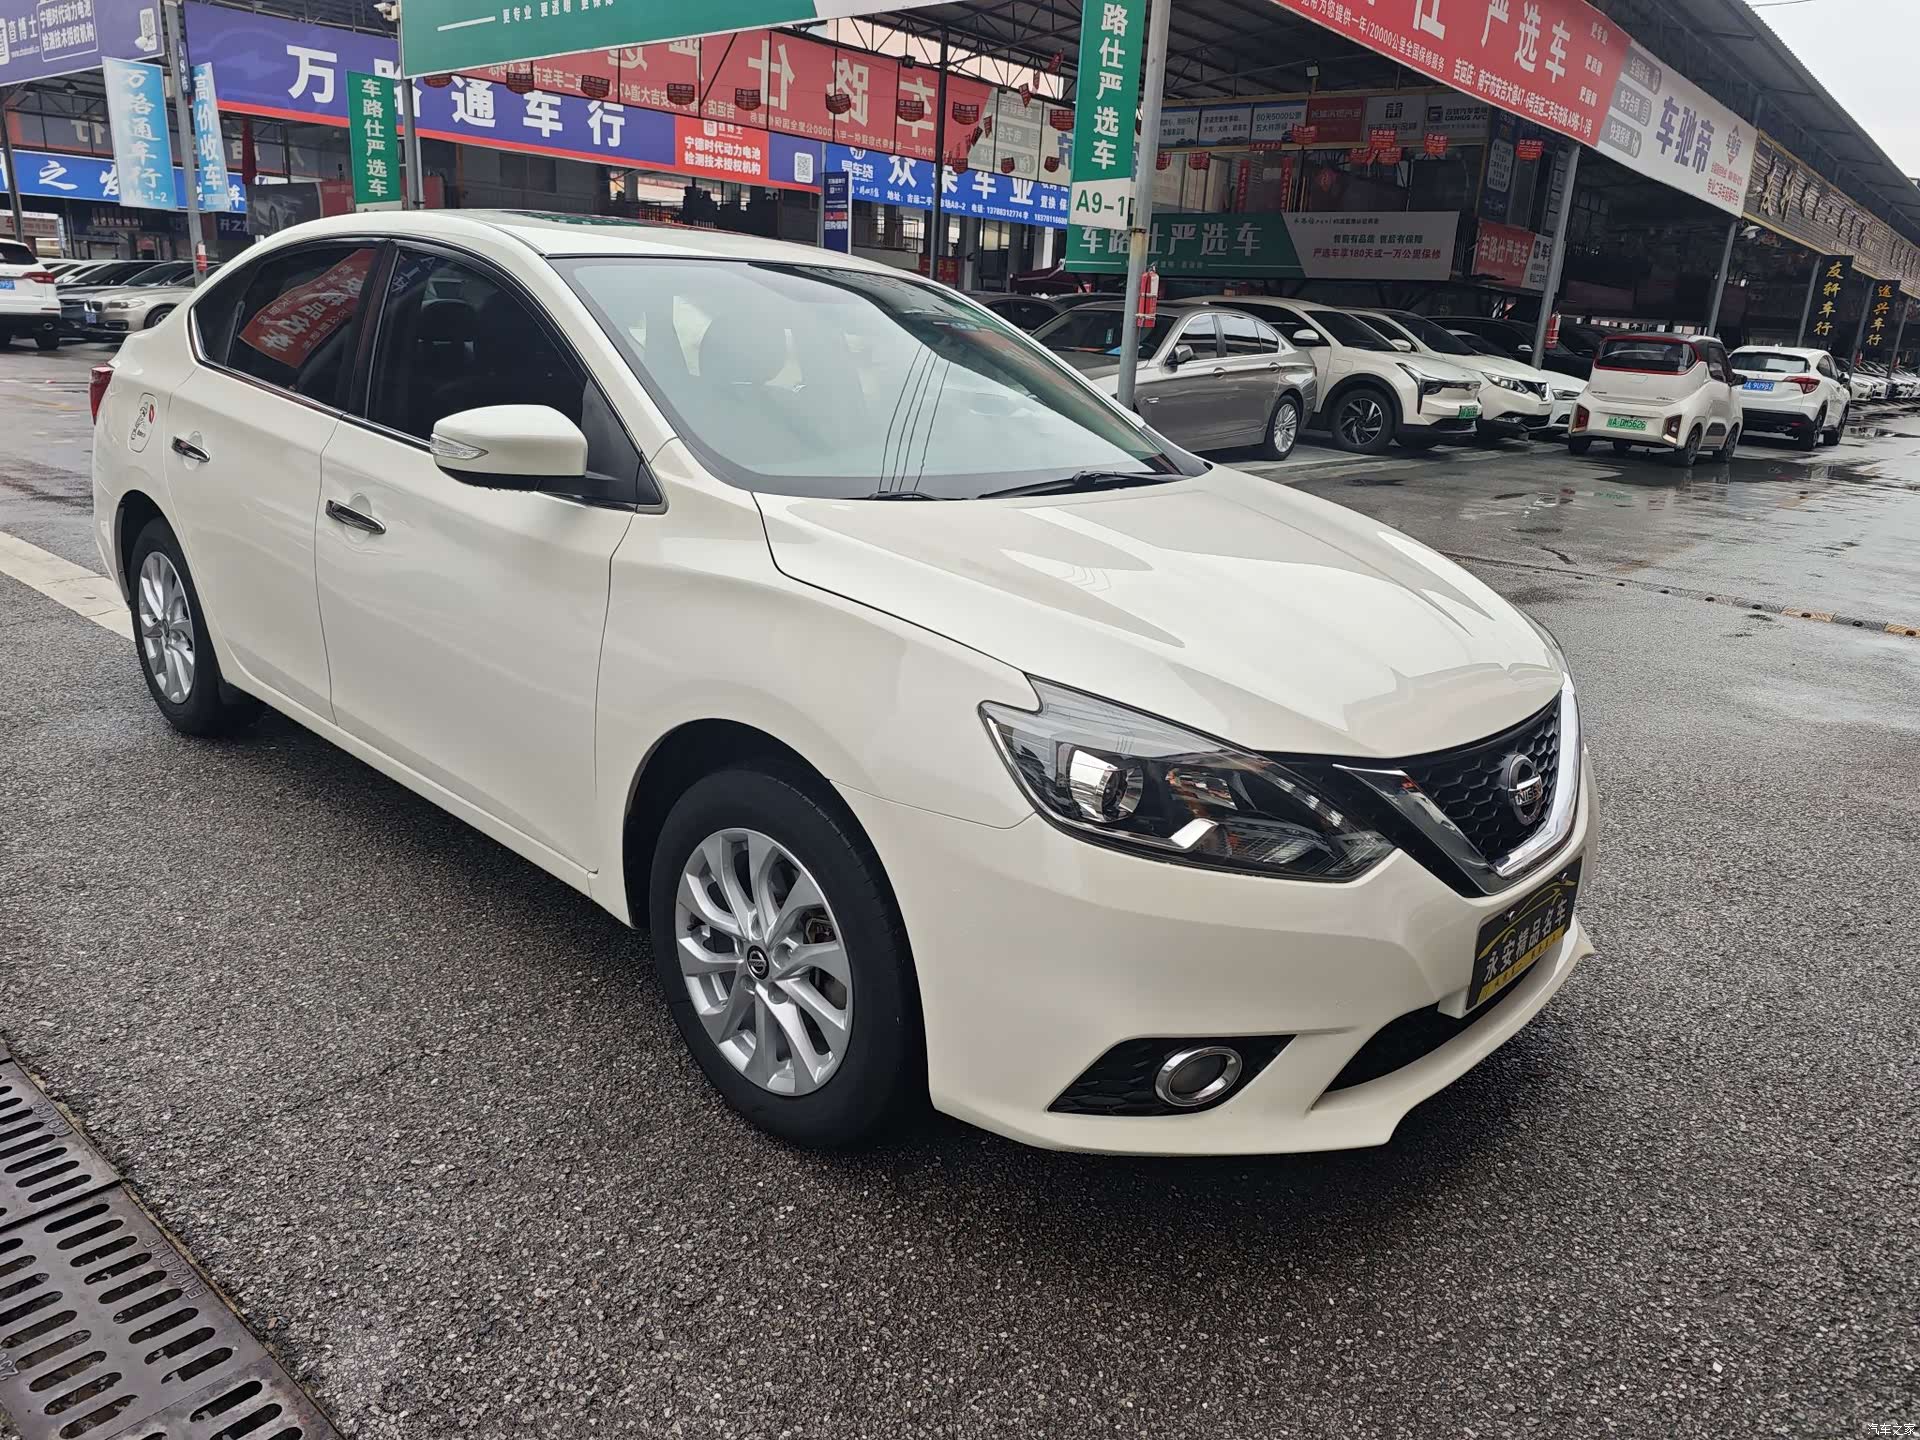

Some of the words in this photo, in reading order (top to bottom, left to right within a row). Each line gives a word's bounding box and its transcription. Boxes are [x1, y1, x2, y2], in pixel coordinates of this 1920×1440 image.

[194, 74, 224, 191] 高价收车
[360, 78, 389, 198] 车路仕严选车
[684, 135, 761, 160] 宁德时代动力电池
[684, 150, 761, 175] 检测技术授权机构
[1484, 898, 1567, 983] 永安精品名车
